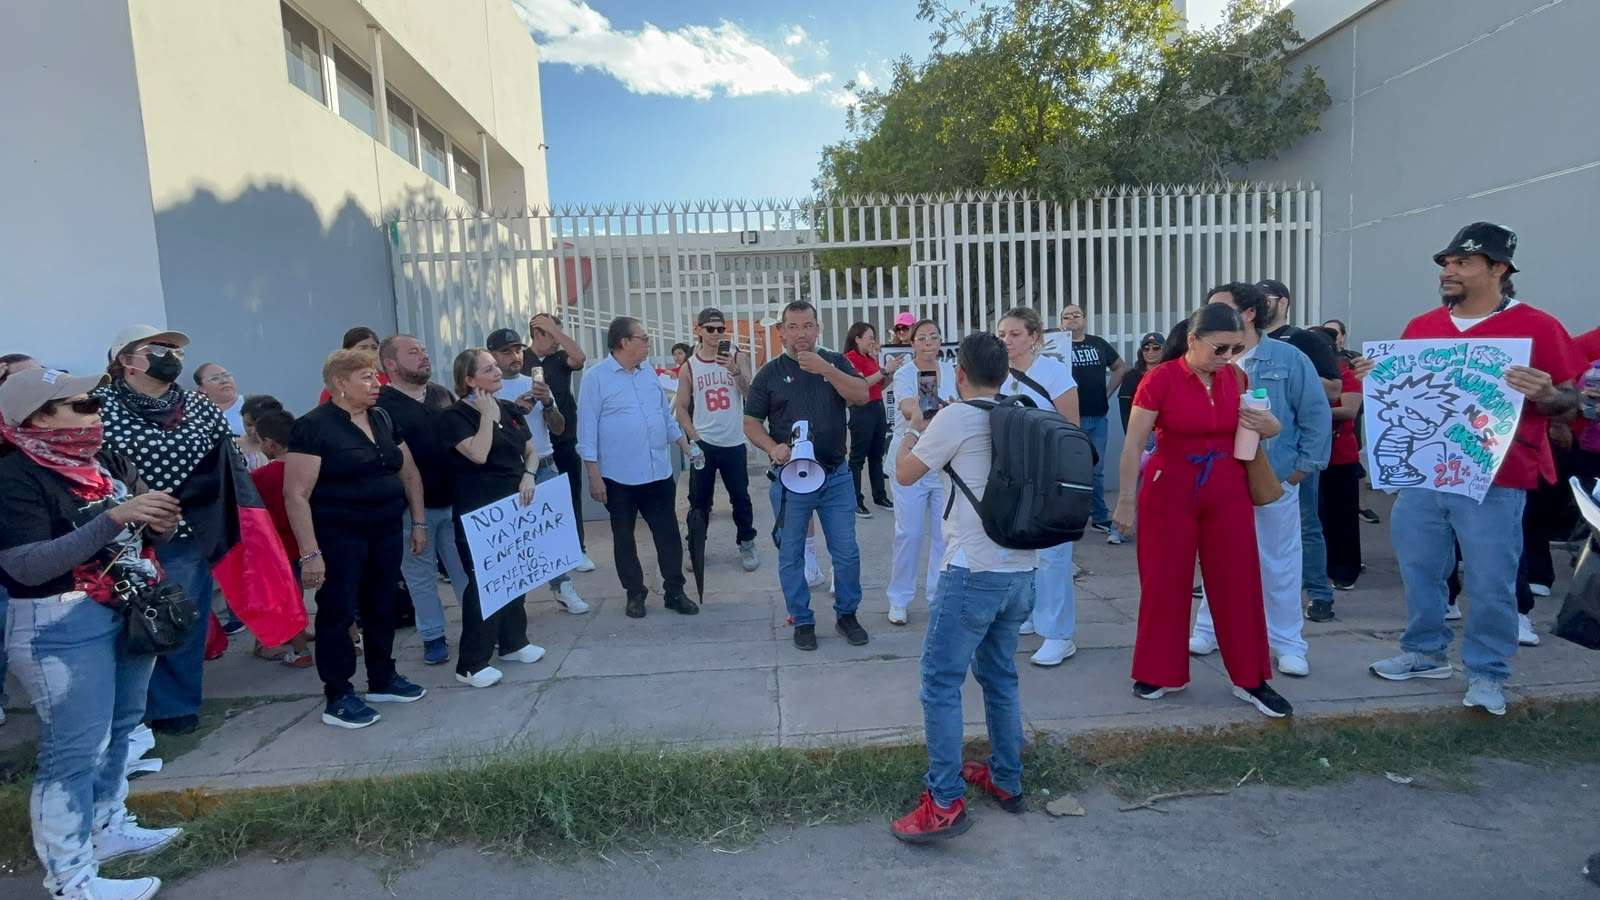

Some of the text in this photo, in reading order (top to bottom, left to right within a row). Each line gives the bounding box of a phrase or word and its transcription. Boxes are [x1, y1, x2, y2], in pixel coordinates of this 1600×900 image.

[697, 371, 735, 392] BULLS
[705, 387, 731, 412] 66
[1462, 403, 1489, 430] NO
[470, 505, 504, 532] NO
[486, 502, 553, 549] VAYAS A
[483, 513, 567, 571] ENFERMAR
[516, 546, 535, 564] NO
[482, 551, 548, 597] TENEMOS
[506, 554, 578, 598] MATERIAL
